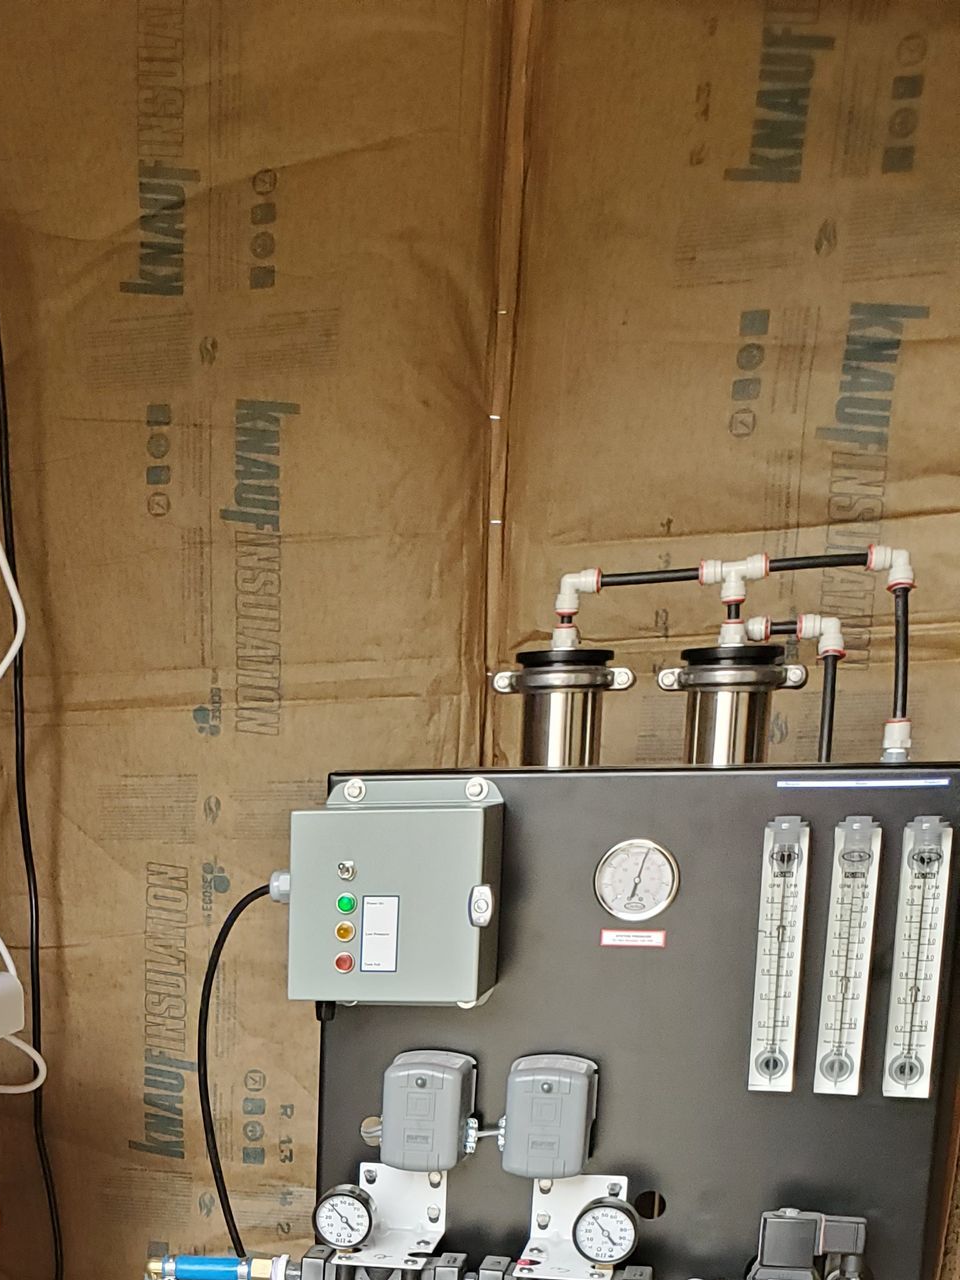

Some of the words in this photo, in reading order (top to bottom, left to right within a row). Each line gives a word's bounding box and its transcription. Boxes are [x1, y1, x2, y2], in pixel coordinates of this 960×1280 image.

[723, 27, 836, 183] KNAUF
[120, 160, 201, 297] KNAUF
[814, 302, 930, 452] KNAUF
[220, 399, 300, 532] KNAUF
[235, 530, 281, 736] INSULATION
[144, 861, 189, 1053] INSULATION
[128, 1048, 198, 1159] KNAUF
[279, 1103, 295, 1121] R
